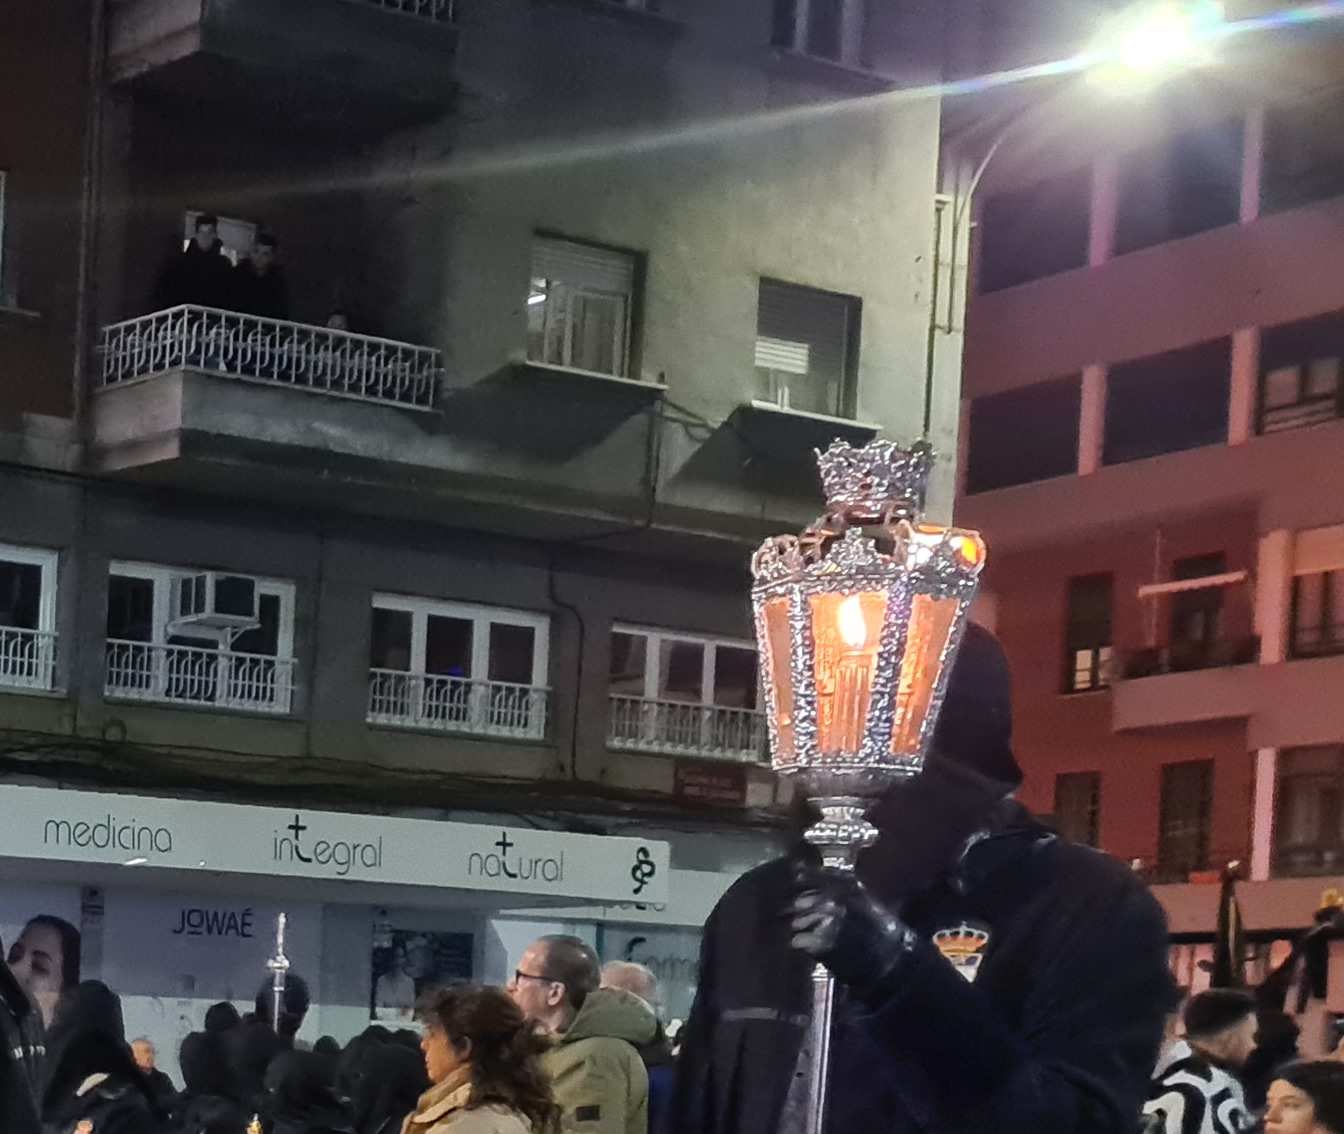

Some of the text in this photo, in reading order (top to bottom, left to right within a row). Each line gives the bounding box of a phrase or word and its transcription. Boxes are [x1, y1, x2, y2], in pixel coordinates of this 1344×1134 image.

[44, 813, 564, 882] medicina integral natural
[172, 907, 254, 938] JOWAÉ
